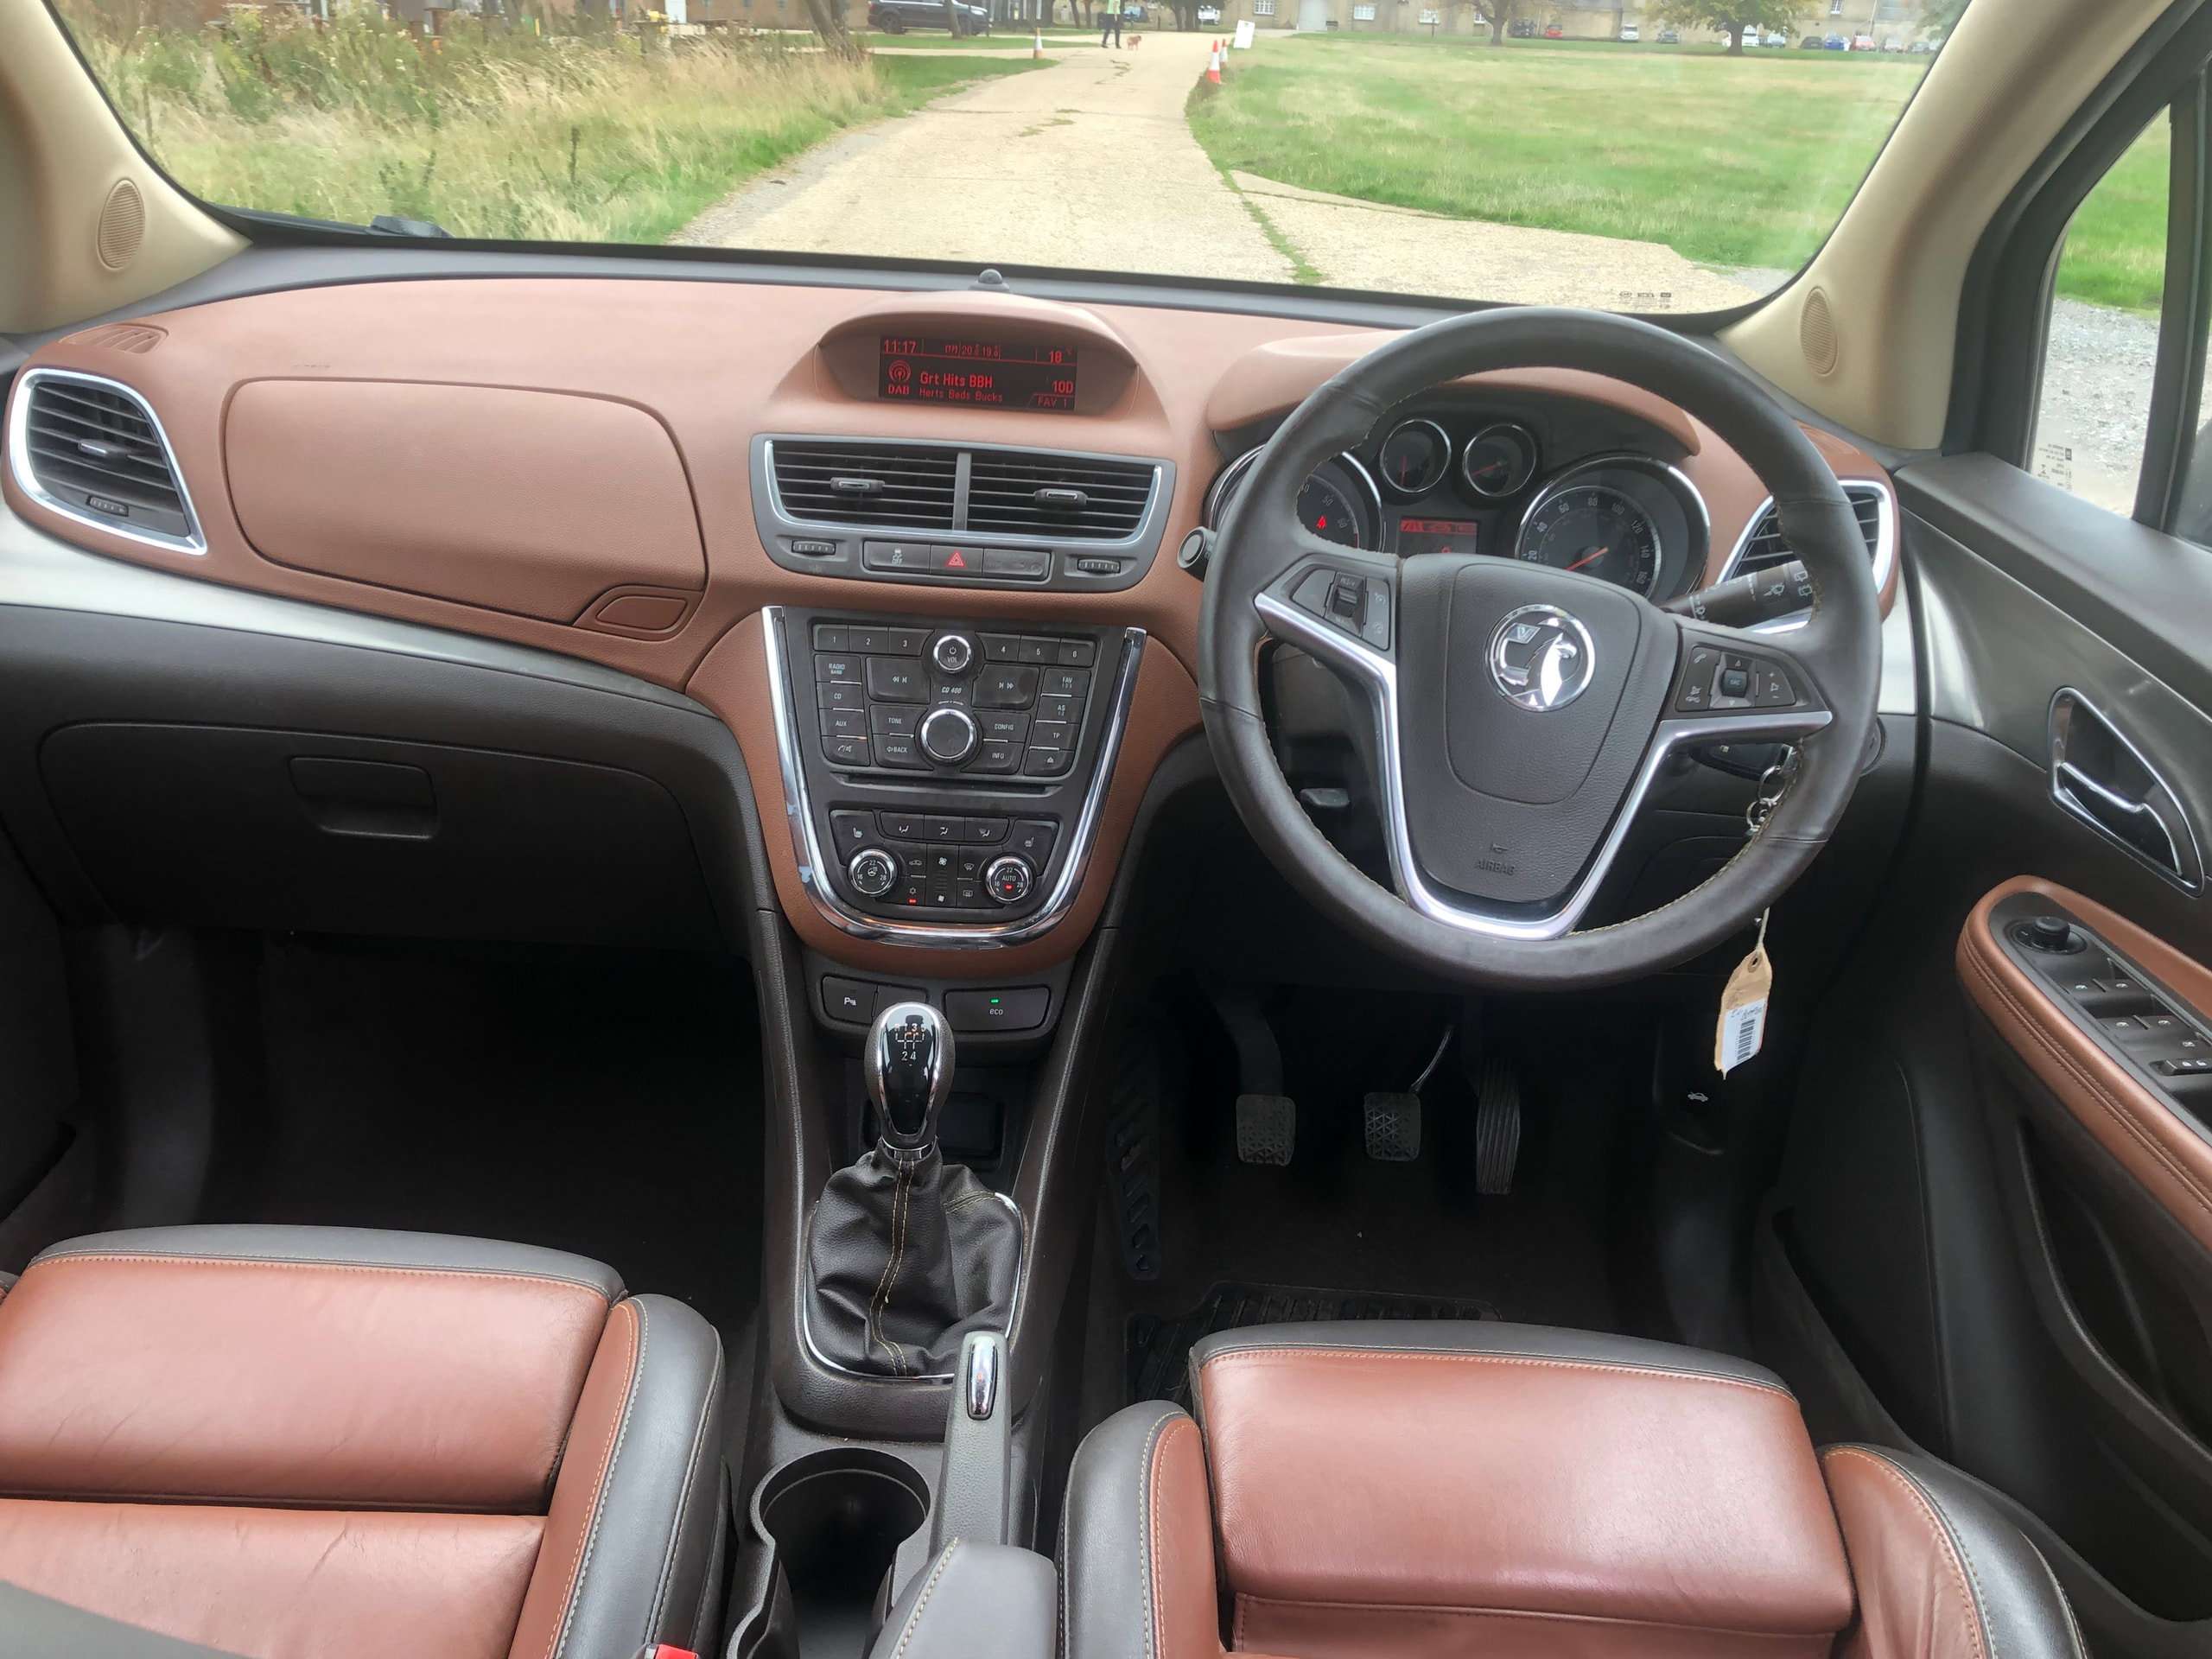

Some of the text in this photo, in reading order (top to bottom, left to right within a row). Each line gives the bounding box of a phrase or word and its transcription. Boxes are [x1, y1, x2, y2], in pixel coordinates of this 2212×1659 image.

[884, 339, 917, 353] 11:17
[919, 371, 993, 388] Grt Hits BBH
[887, 385, 910, 395] DAB
[919, 387, 944, 398] Herts
[975, 391, 1003, 403] Bucks
[1037, 396, 1058, 407] FAV
[1630, 520, 1644, 534] 120
[912, 1023, 918, 1032] 3
[901, 1052, 917, 1061] 2 4
